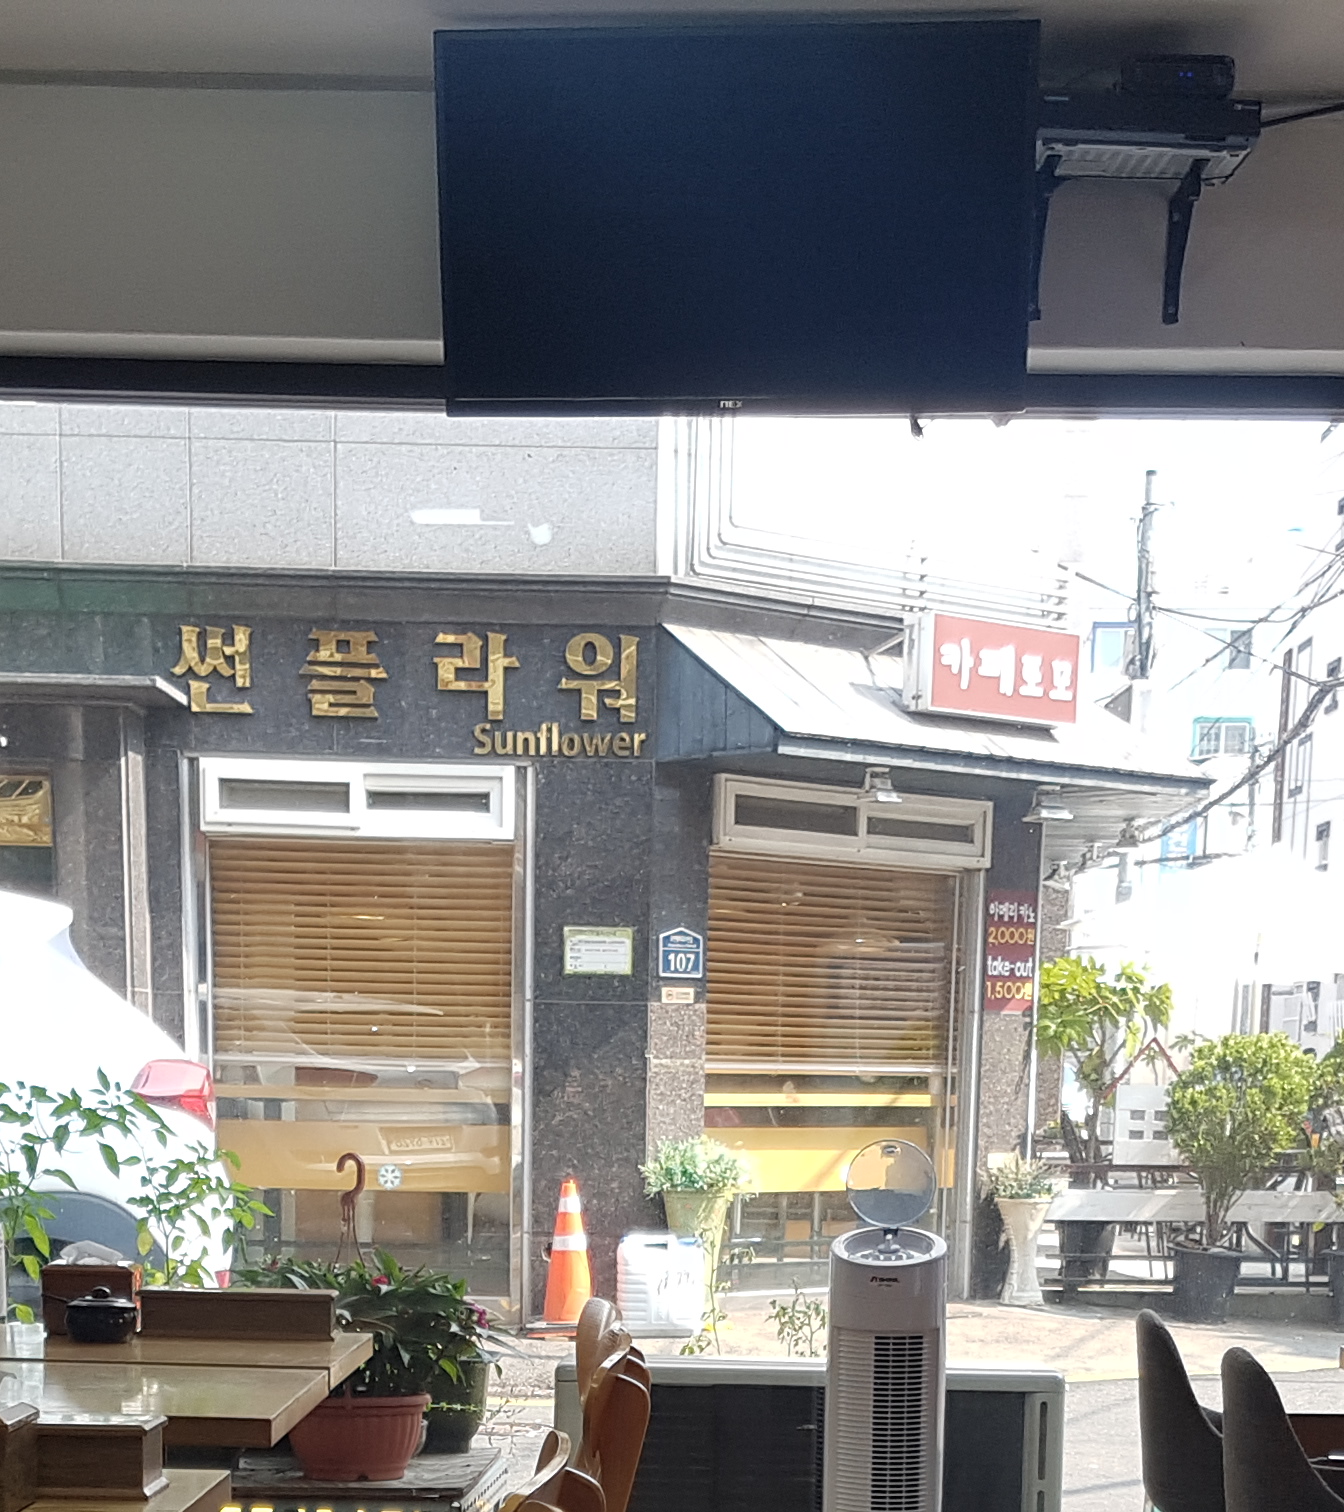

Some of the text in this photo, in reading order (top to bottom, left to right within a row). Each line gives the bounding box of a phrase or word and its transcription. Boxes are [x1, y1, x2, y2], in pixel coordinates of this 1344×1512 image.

[170, 623, 641, 723] 썬플라워
[472, 722, 647, 757] Sunflower
[988, 927, 1035, 945] 2,000원
[667, 952, 696, 972] 107
[987, 955, 1033, 978] take-out
